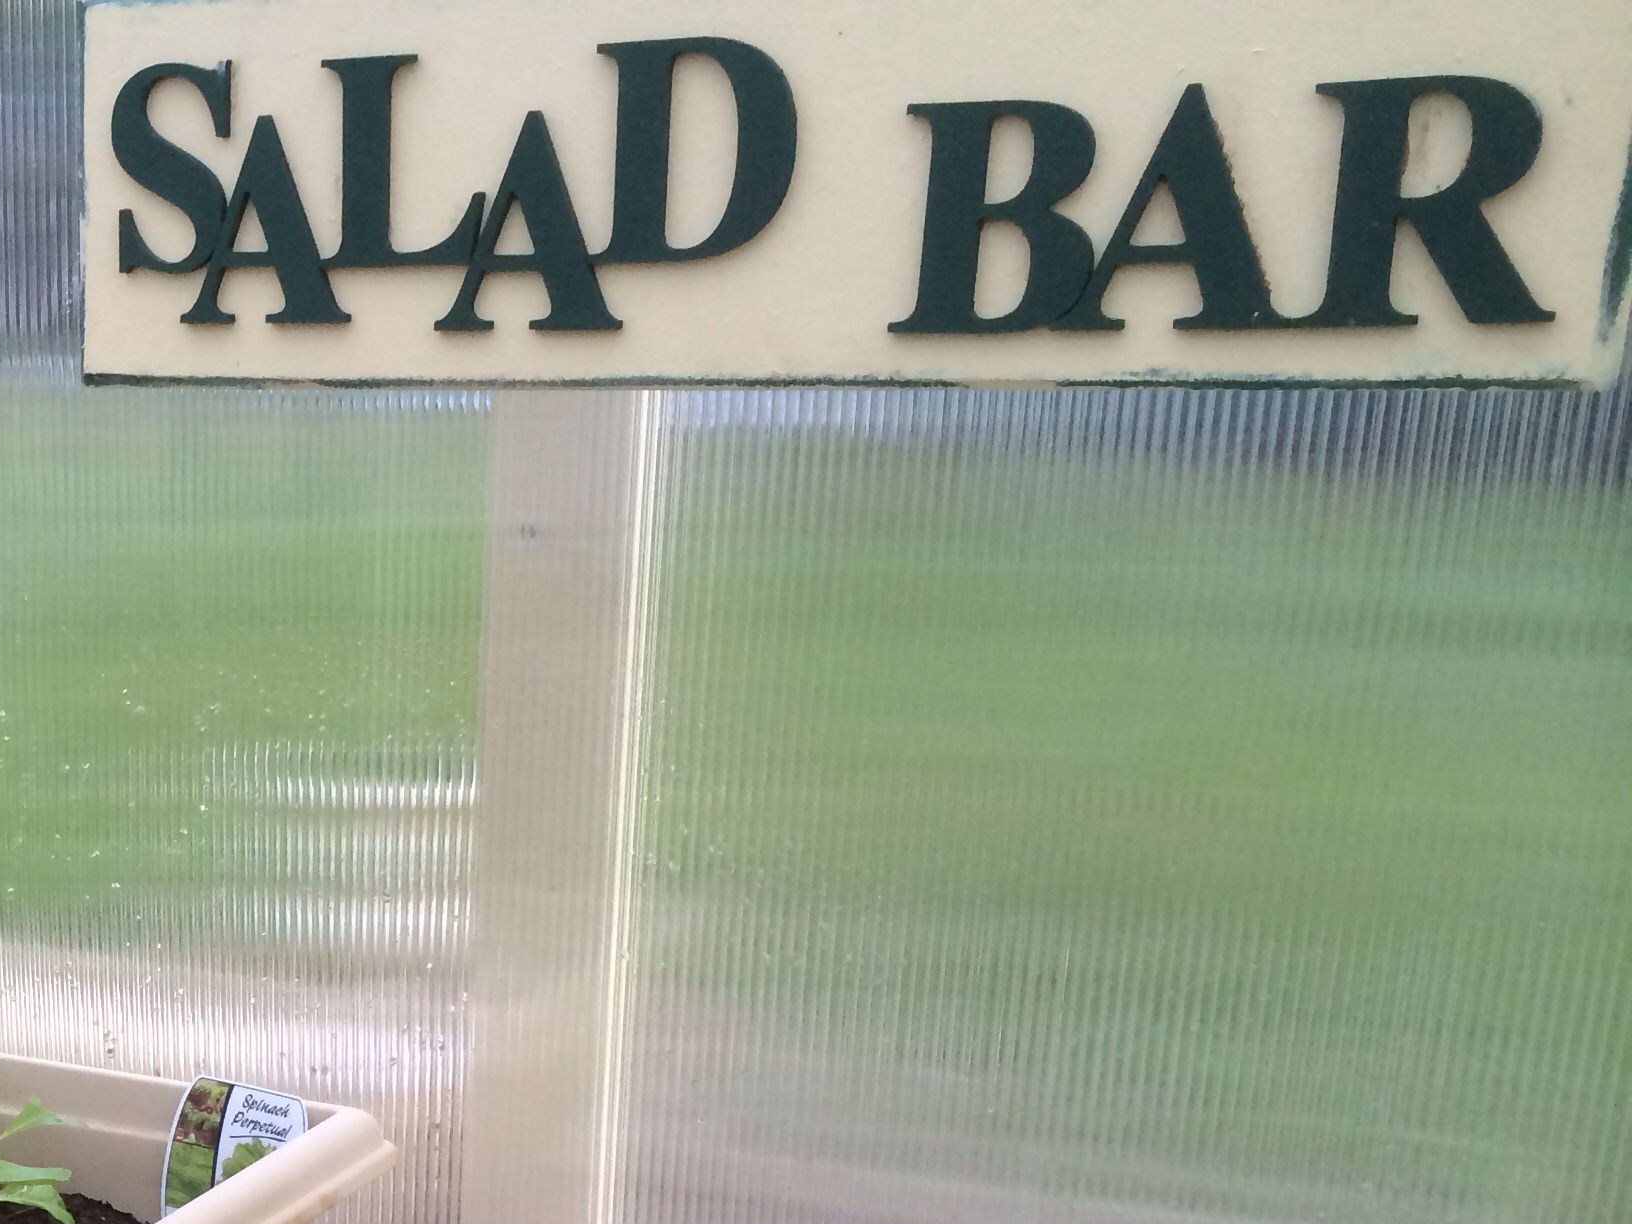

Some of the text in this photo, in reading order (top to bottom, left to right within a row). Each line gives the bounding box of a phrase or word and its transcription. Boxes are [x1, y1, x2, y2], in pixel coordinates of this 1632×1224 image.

[109, 34, 1557, 336] SALAD BAR
[241, 1093, 291, 1119] Spinach
[231, 1111, 293, 1139] Perpetual
